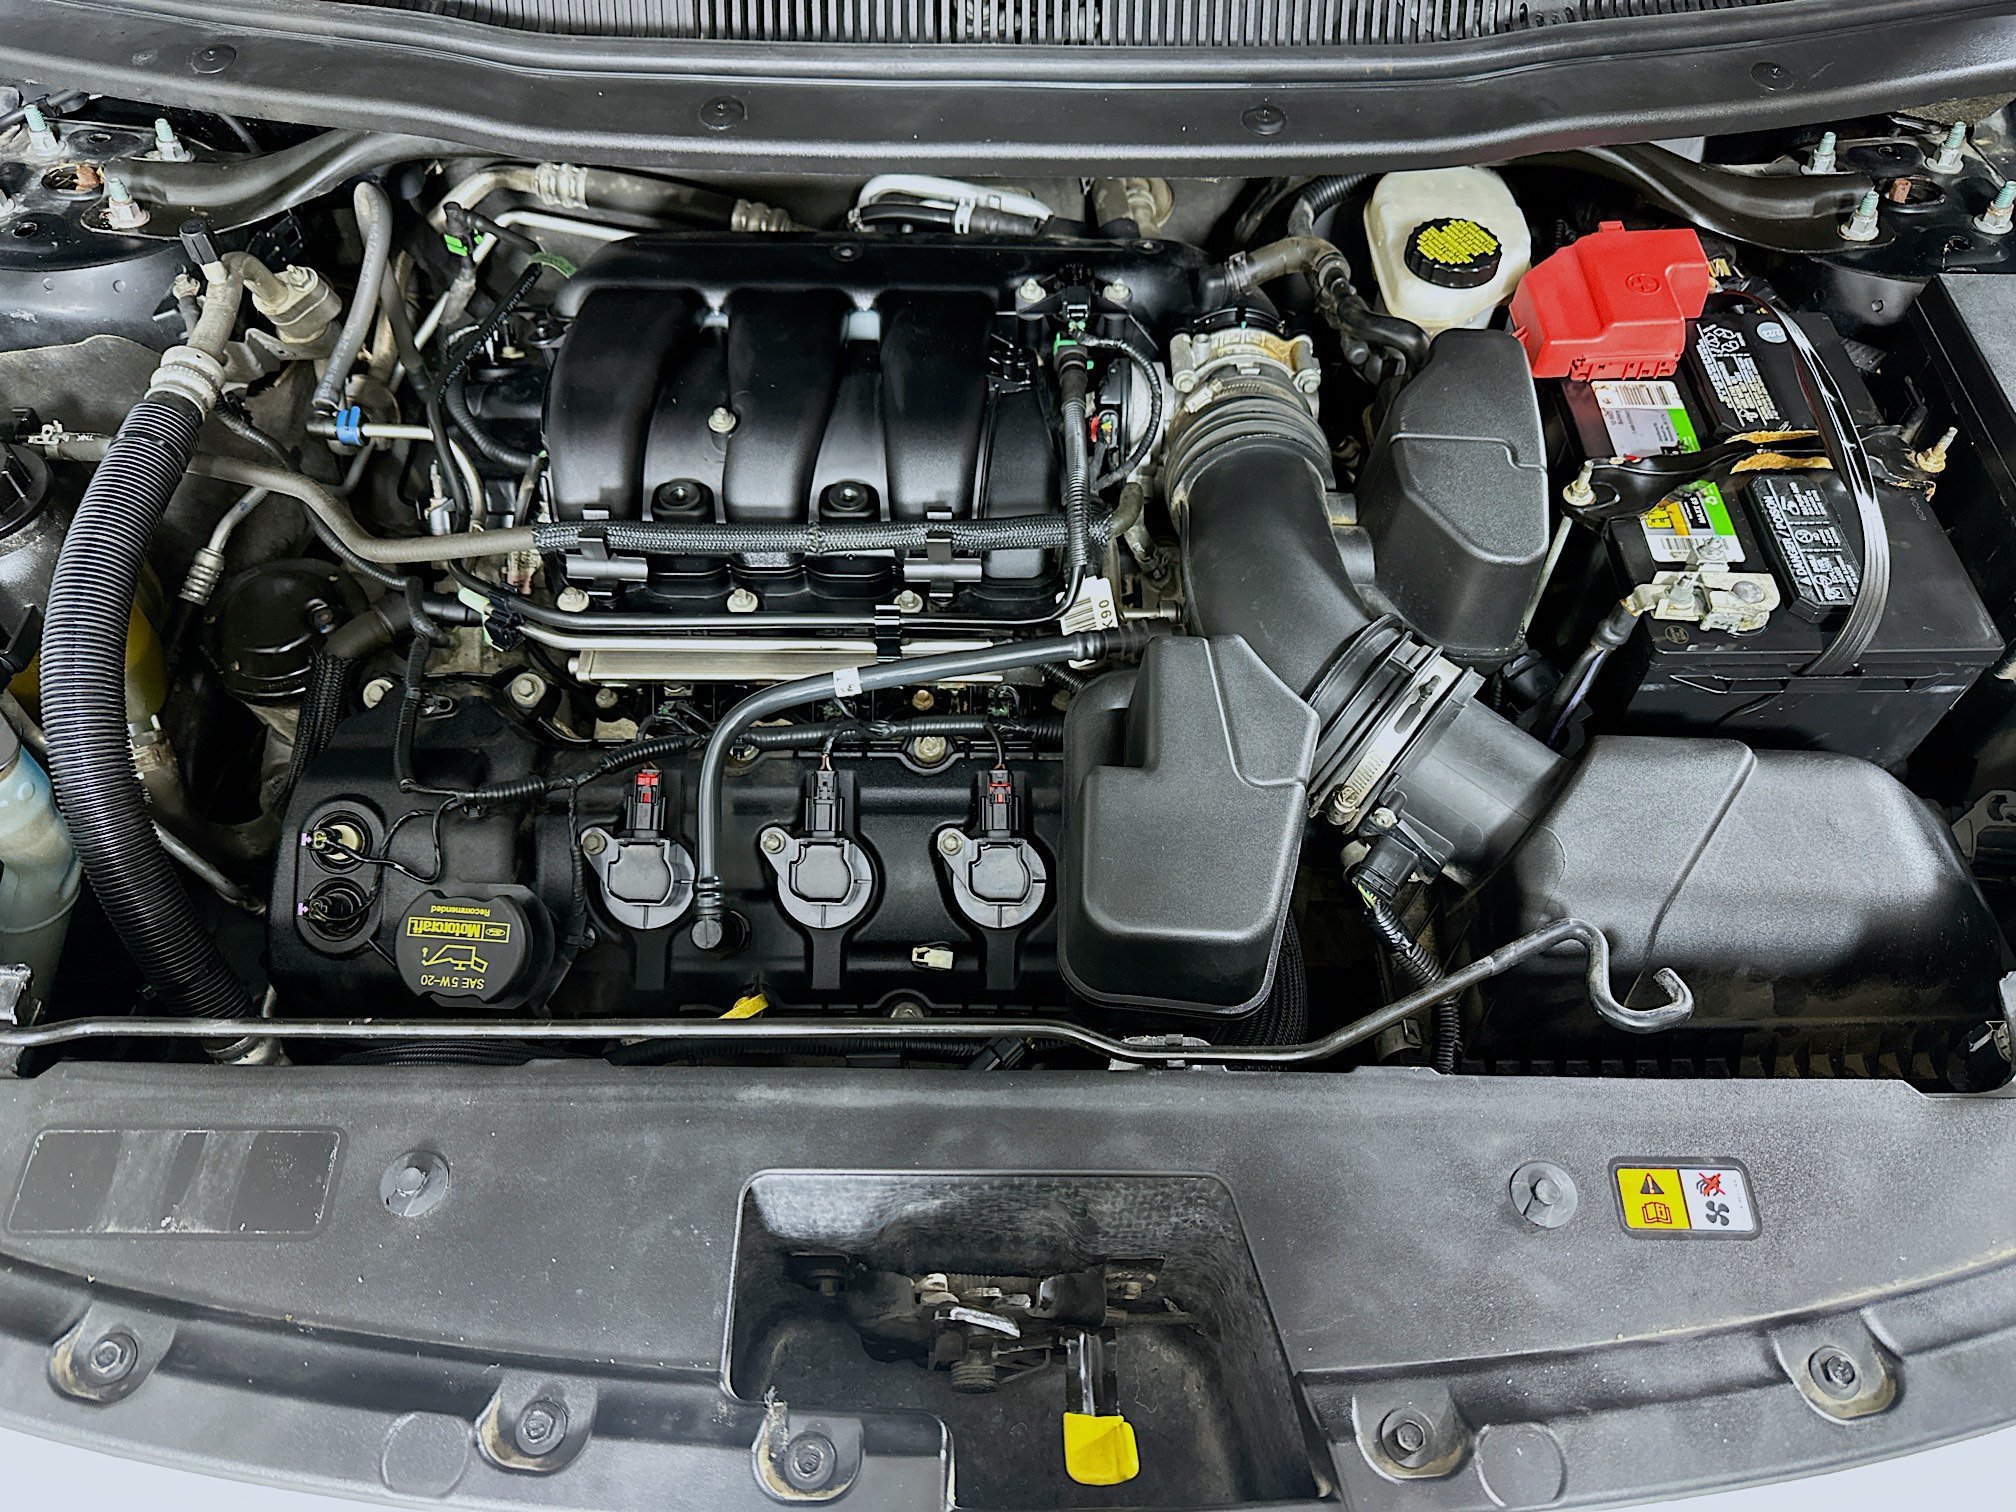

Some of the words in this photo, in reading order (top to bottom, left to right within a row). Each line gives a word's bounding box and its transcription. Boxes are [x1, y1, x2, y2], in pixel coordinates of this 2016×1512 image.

[1762, 495, 1787, 530] POISON
[1781, 537, 1808, 576] DANGER
[430, 905, 491, 917] Recommended
[410, 918, 481, 938] Motorcraft
[420, 974, 459, 988] 5W-20
[461, 977, 485, 990] SAE
